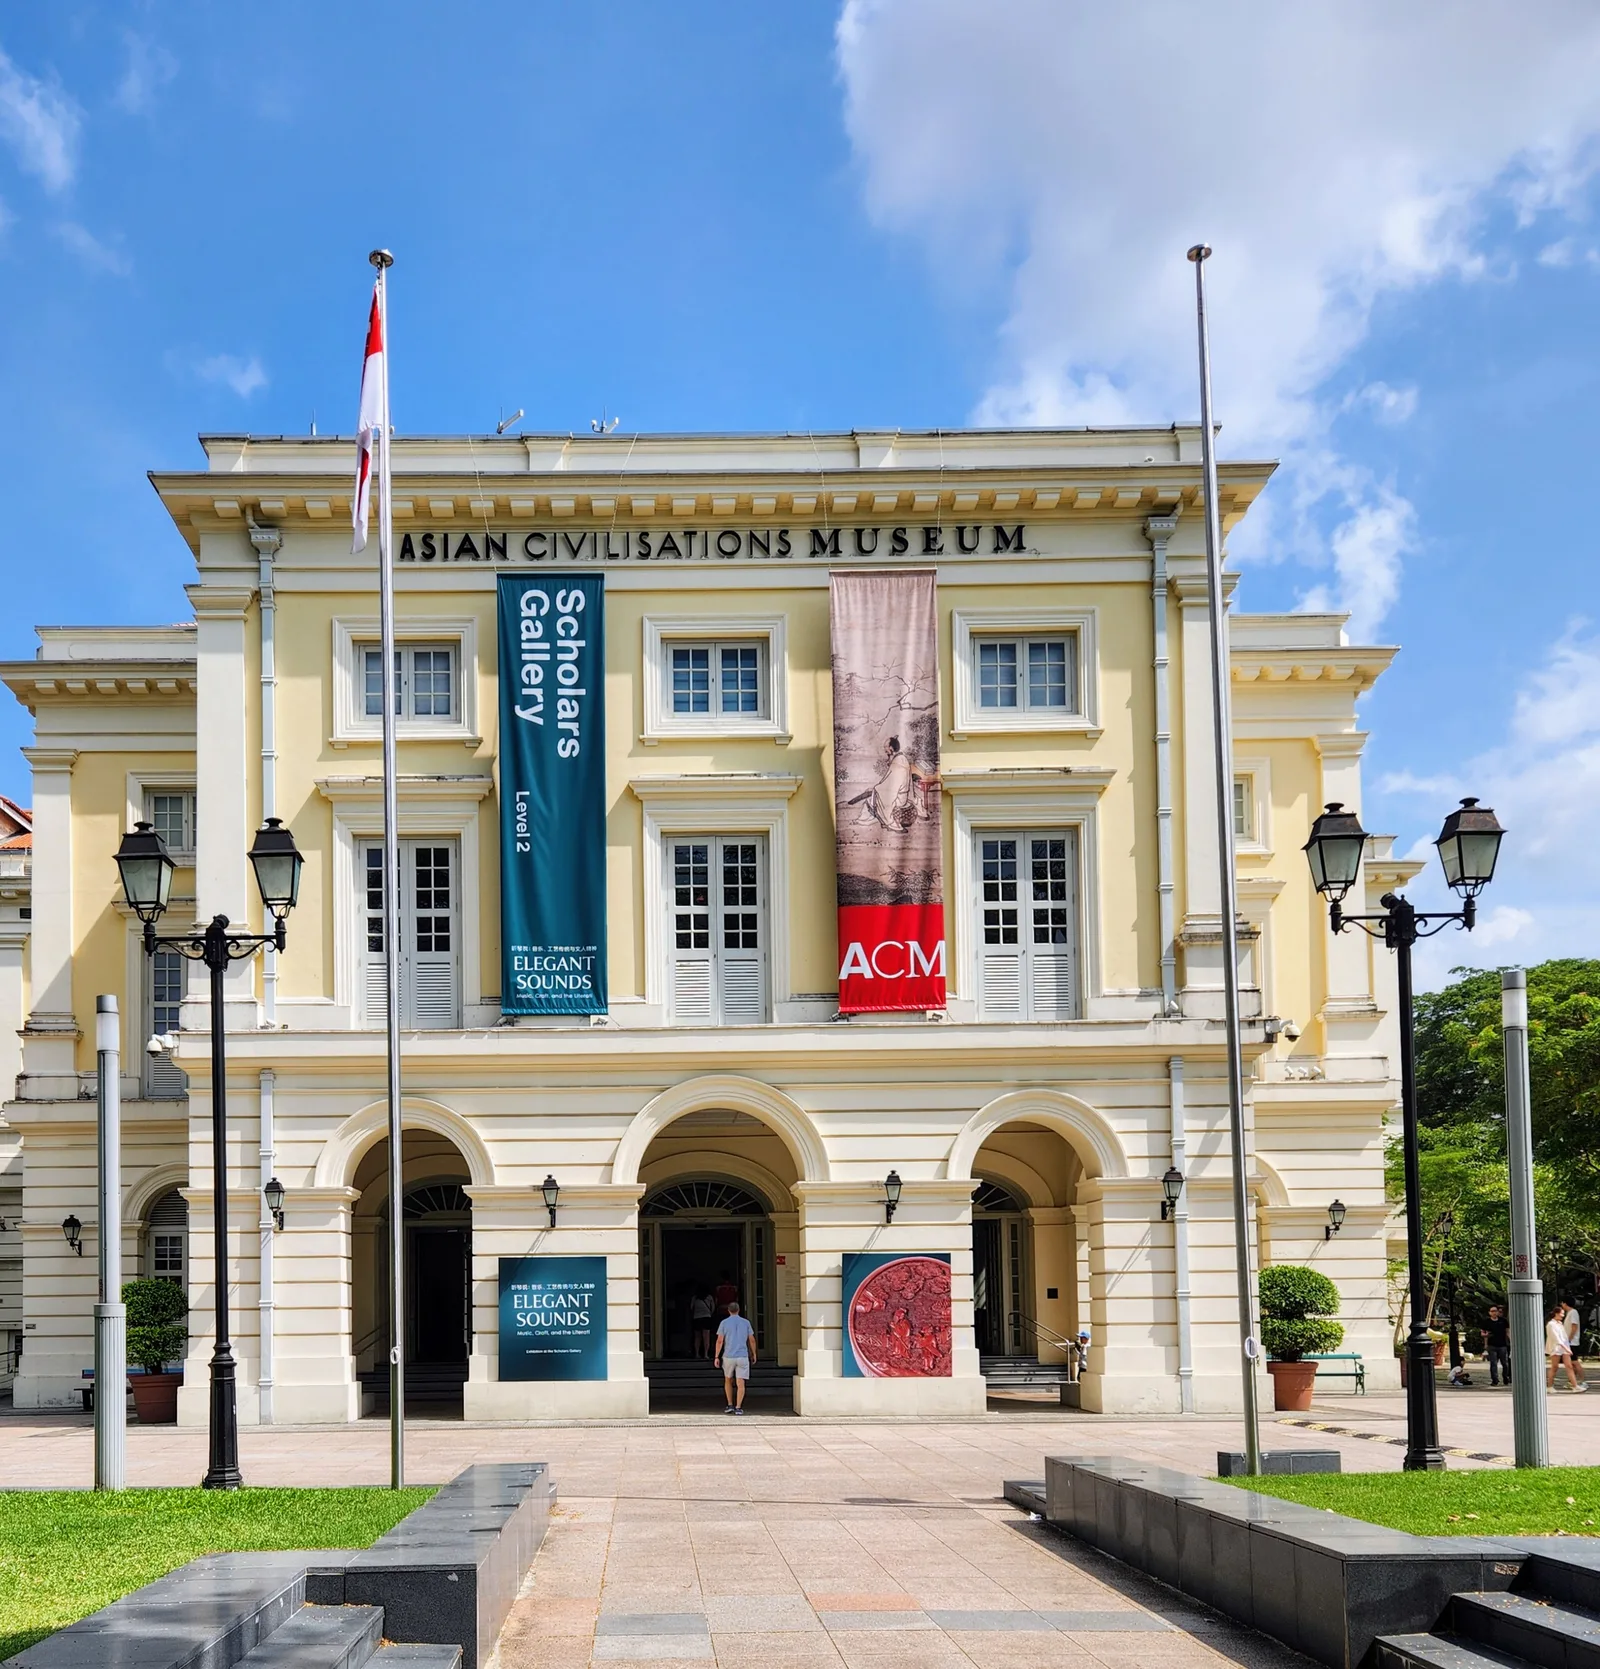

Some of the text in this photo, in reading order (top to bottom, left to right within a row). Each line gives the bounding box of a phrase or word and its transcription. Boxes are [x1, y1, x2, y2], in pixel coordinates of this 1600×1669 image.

[399, 525, 1027, 560] ASIAN CIVILISATIONS MUSEUM
[514, 588, 551, 726] Gallery
[555, 588, 587, 759] Scholars
[515, 790, 531, 853] Level 2
[514, 956, 595, 970] ELEGANT
[838, 940, 947, 980] ACM
[516, 974, 592, 990] SOUNDS
[513, 1293, 593, 1309] ELEGANT
[516, 1311, 590, 1327] SOUNDS
